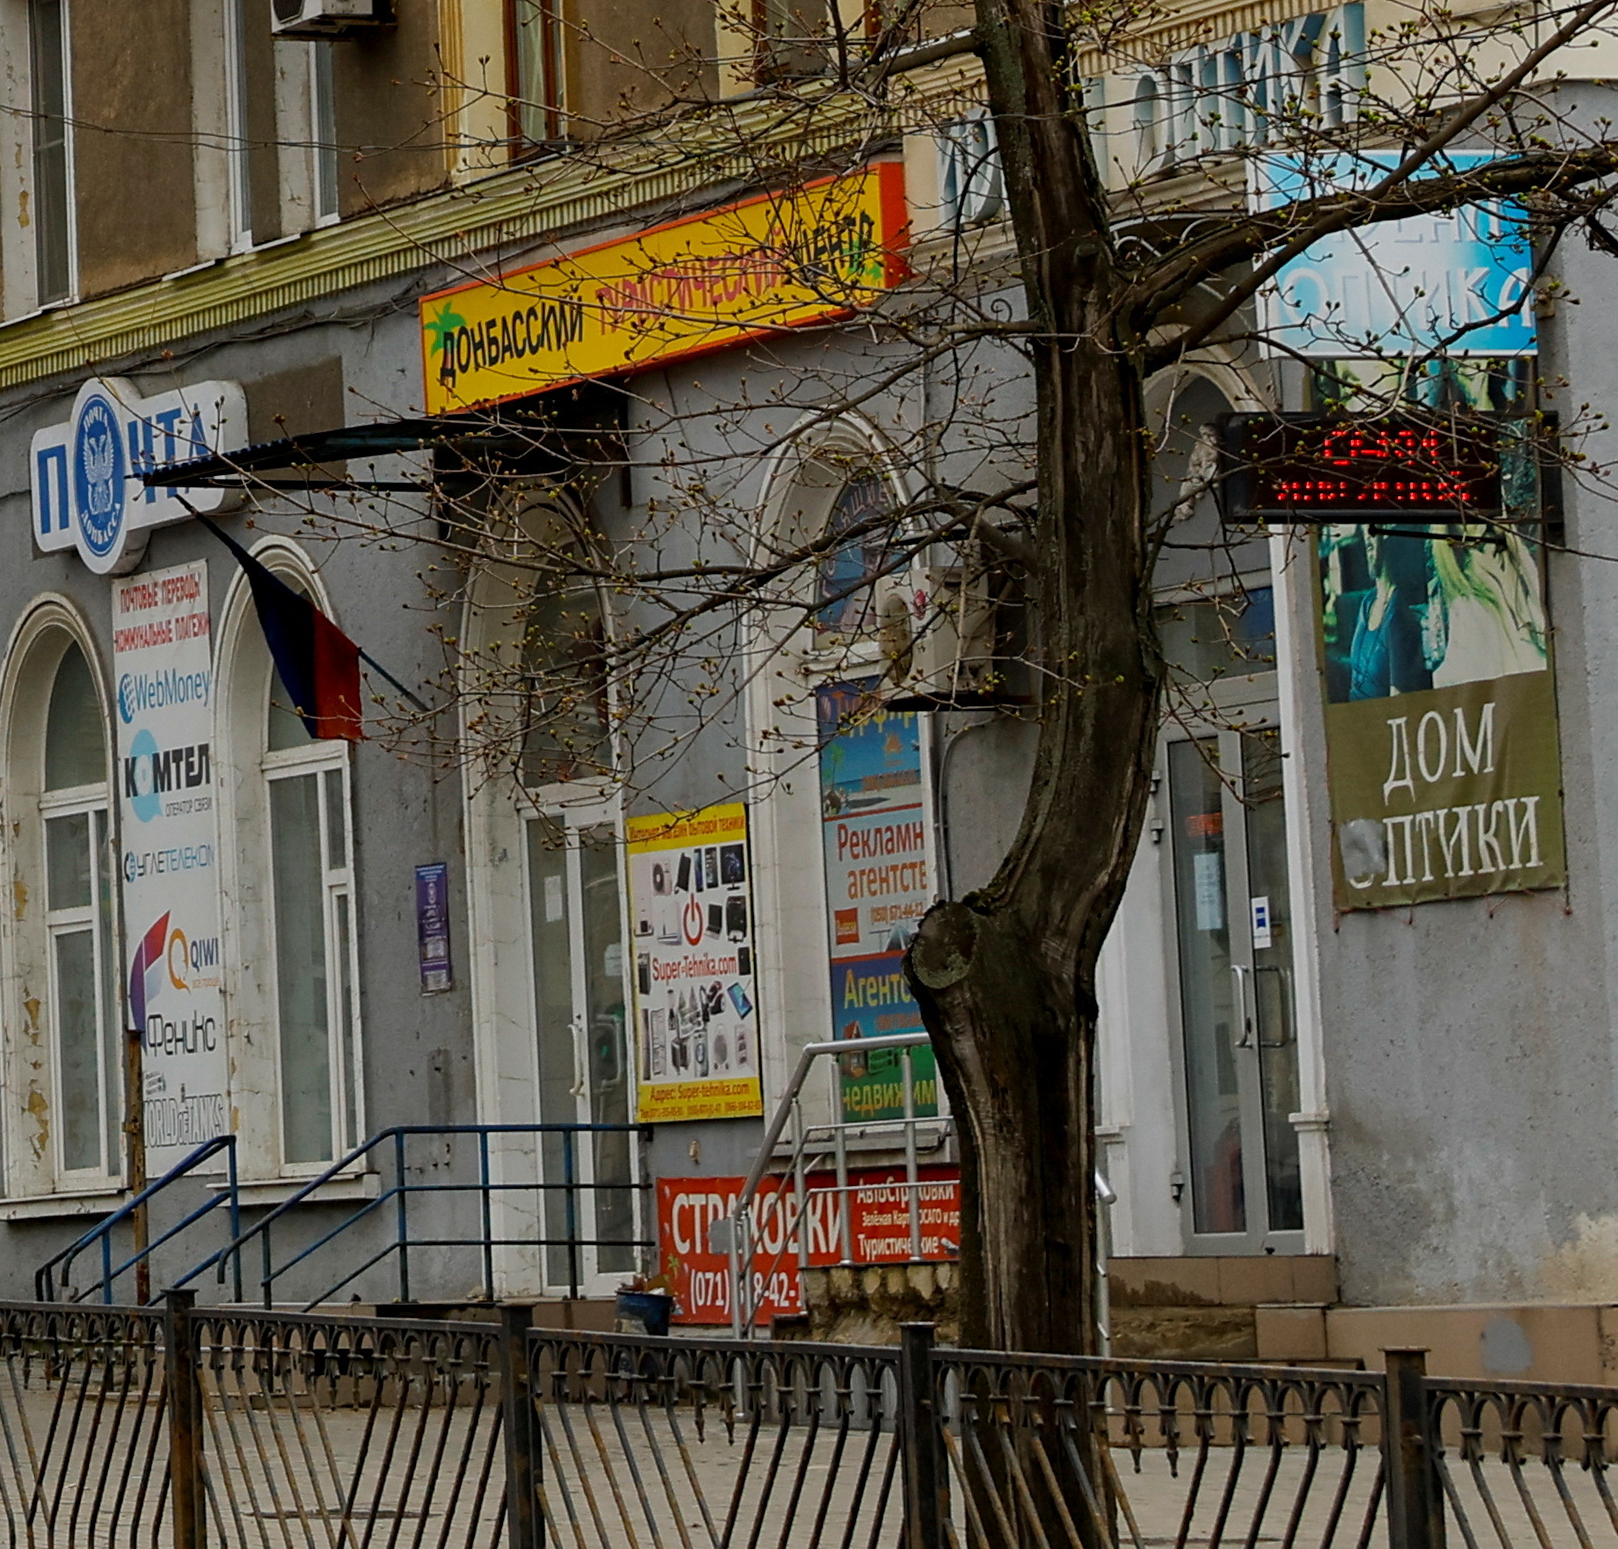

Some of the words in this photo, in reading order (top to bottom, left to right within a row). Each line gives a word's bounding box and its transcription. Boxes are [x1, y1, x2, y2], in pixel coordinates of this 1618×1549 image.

[440, 294, 583, 388] ДОНБАССКИЙ
[596, 228, 786, 336] ТУРИСТИЧЕСКИЙ
[135, 668, 210, 710] WebMoney
[1383, 702, 1497, 805] ДОМ
[1350, 796, 1543, 889] ПТИКИ
[191, 938, 219, 972] QIWI
[147, 1010, 216, 1057] Феникс
[691, 1269, 729, 1314] (071)
